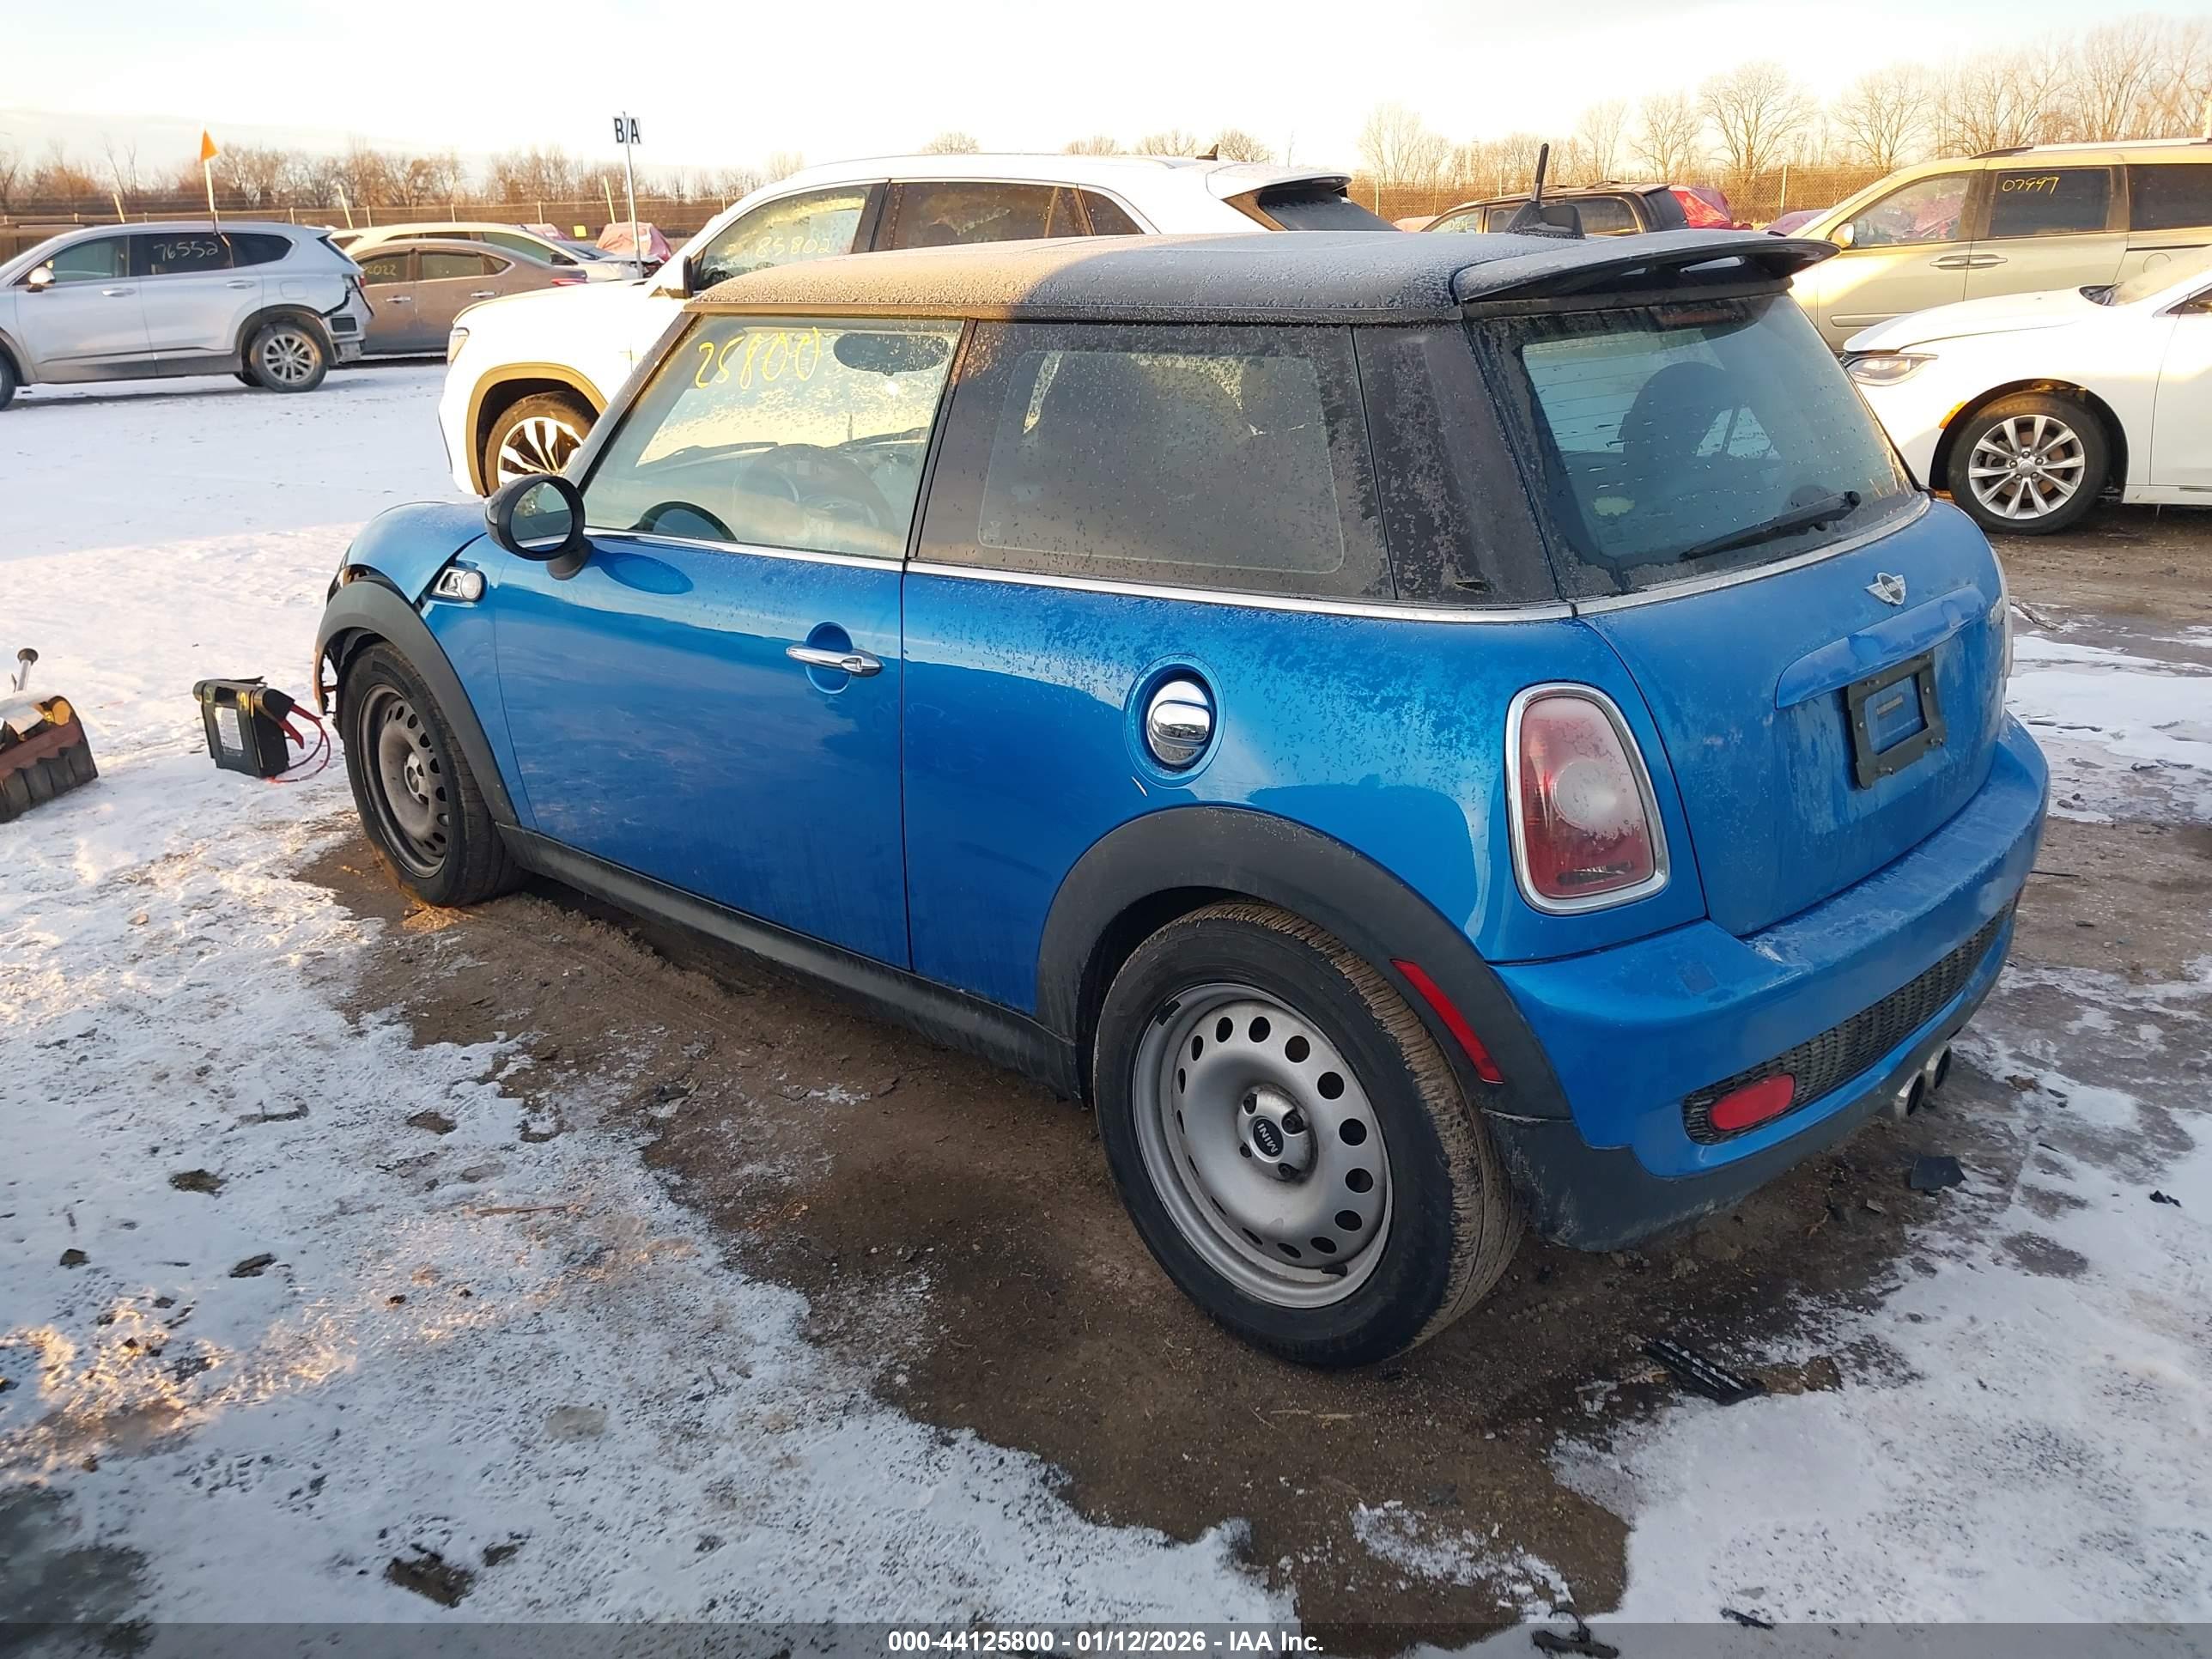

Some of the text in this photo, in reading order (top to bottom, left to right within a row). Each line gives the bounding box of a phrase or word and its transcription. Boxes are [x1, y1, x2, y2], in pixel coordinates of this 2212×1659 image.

[614, 118, 641, 144] B/A
[154, 241, 219, 262] 76552
[756, 235, 830, 258] 85802
[695, 326, 822, 389] 25800
[1257, 1123, 1279, 1153] MINI
